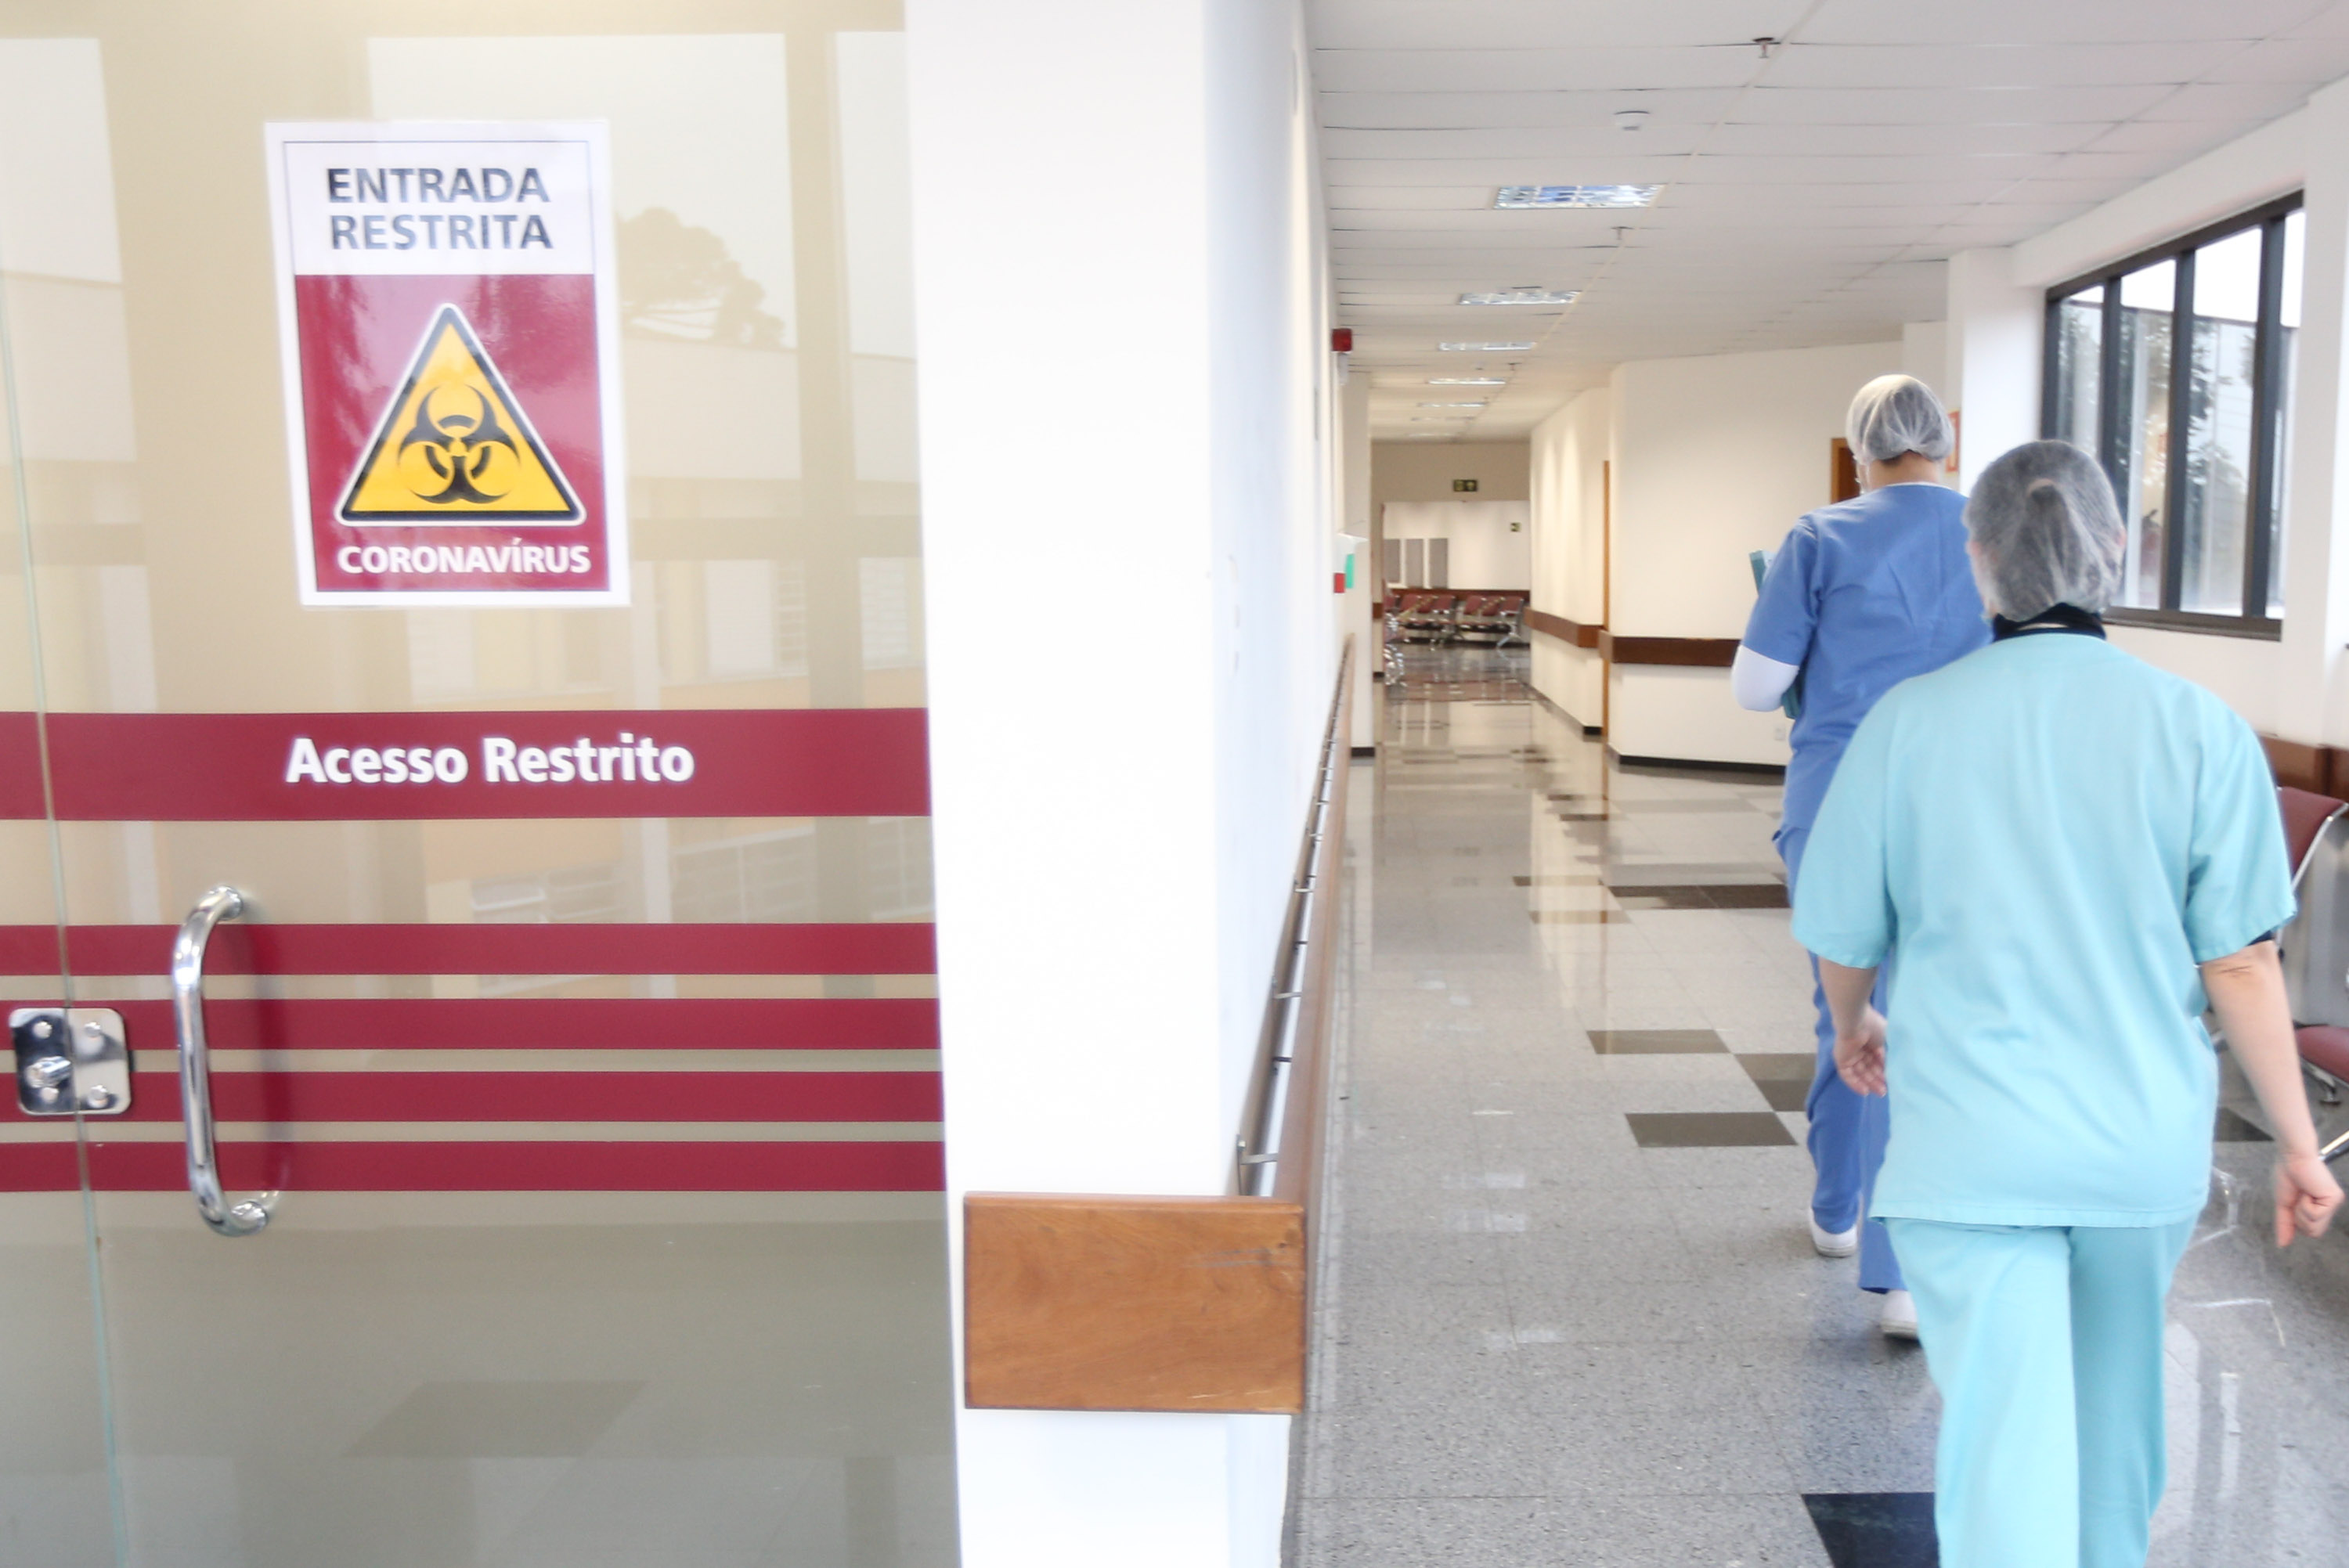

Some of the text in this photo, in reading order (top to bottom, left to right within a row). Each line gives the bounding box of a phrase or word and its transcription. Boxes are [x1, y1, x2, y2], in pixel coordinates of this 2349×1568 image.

[326, 168, 550, 204] ENTRADA
[330, 214, 554, 251] RESTRITA
[337, 537, 593, 575] CORONAVÍRUS
[285, 732, 695, 784] Acesso Restrito
